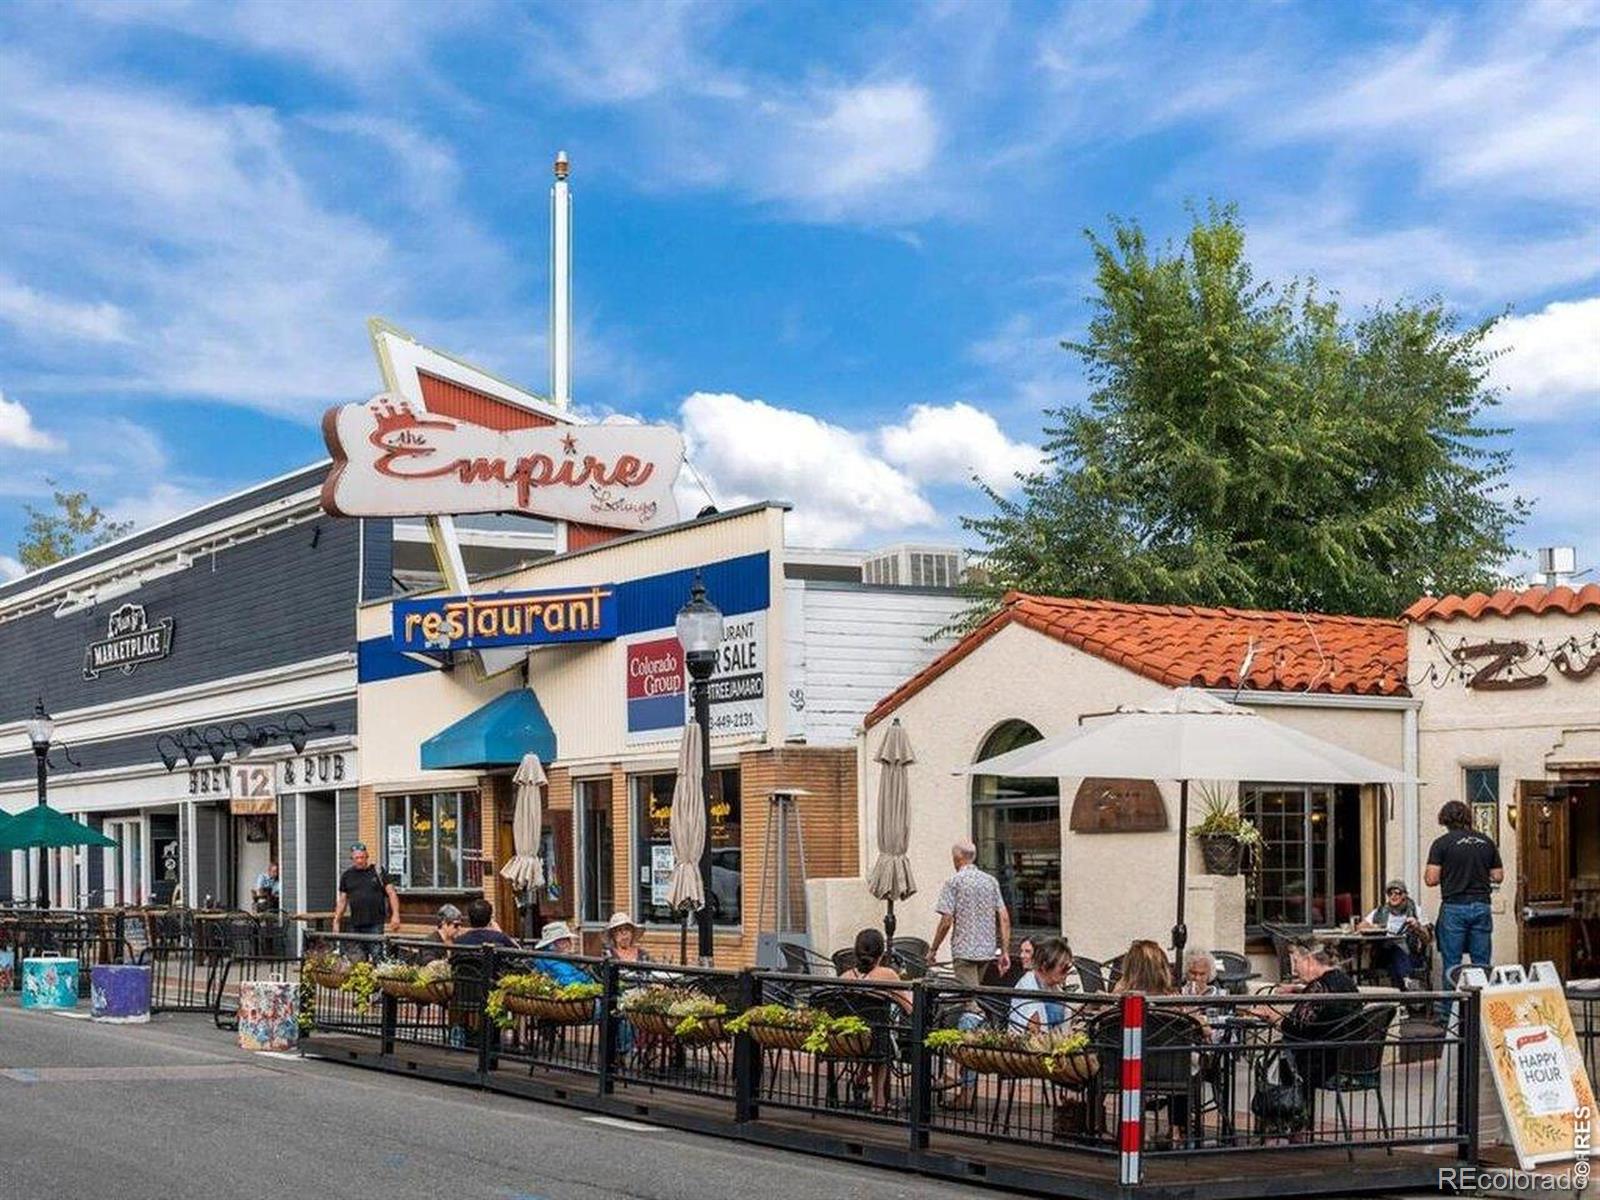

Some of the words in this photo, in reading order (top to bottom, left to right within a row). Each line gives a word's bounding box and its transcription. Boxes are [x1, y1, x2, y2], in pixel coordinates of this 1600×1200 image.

[369, 410, 654, 508] Empire
[405, 587, 613, 643] restaurant
[94, 632, 160, 666] MARKETPLACE
[723, 642, 757, 672] SALE
[630, 653, 677, 678] Colorado
[643, 674, 682, 697] Group
[236, 769, 271, 797] 12
[304, 754, 346, 784] PUB
[1518, 1052, 1557, 1068] HAPPY
[1524, 1067, 1562, 1083] HOUR
